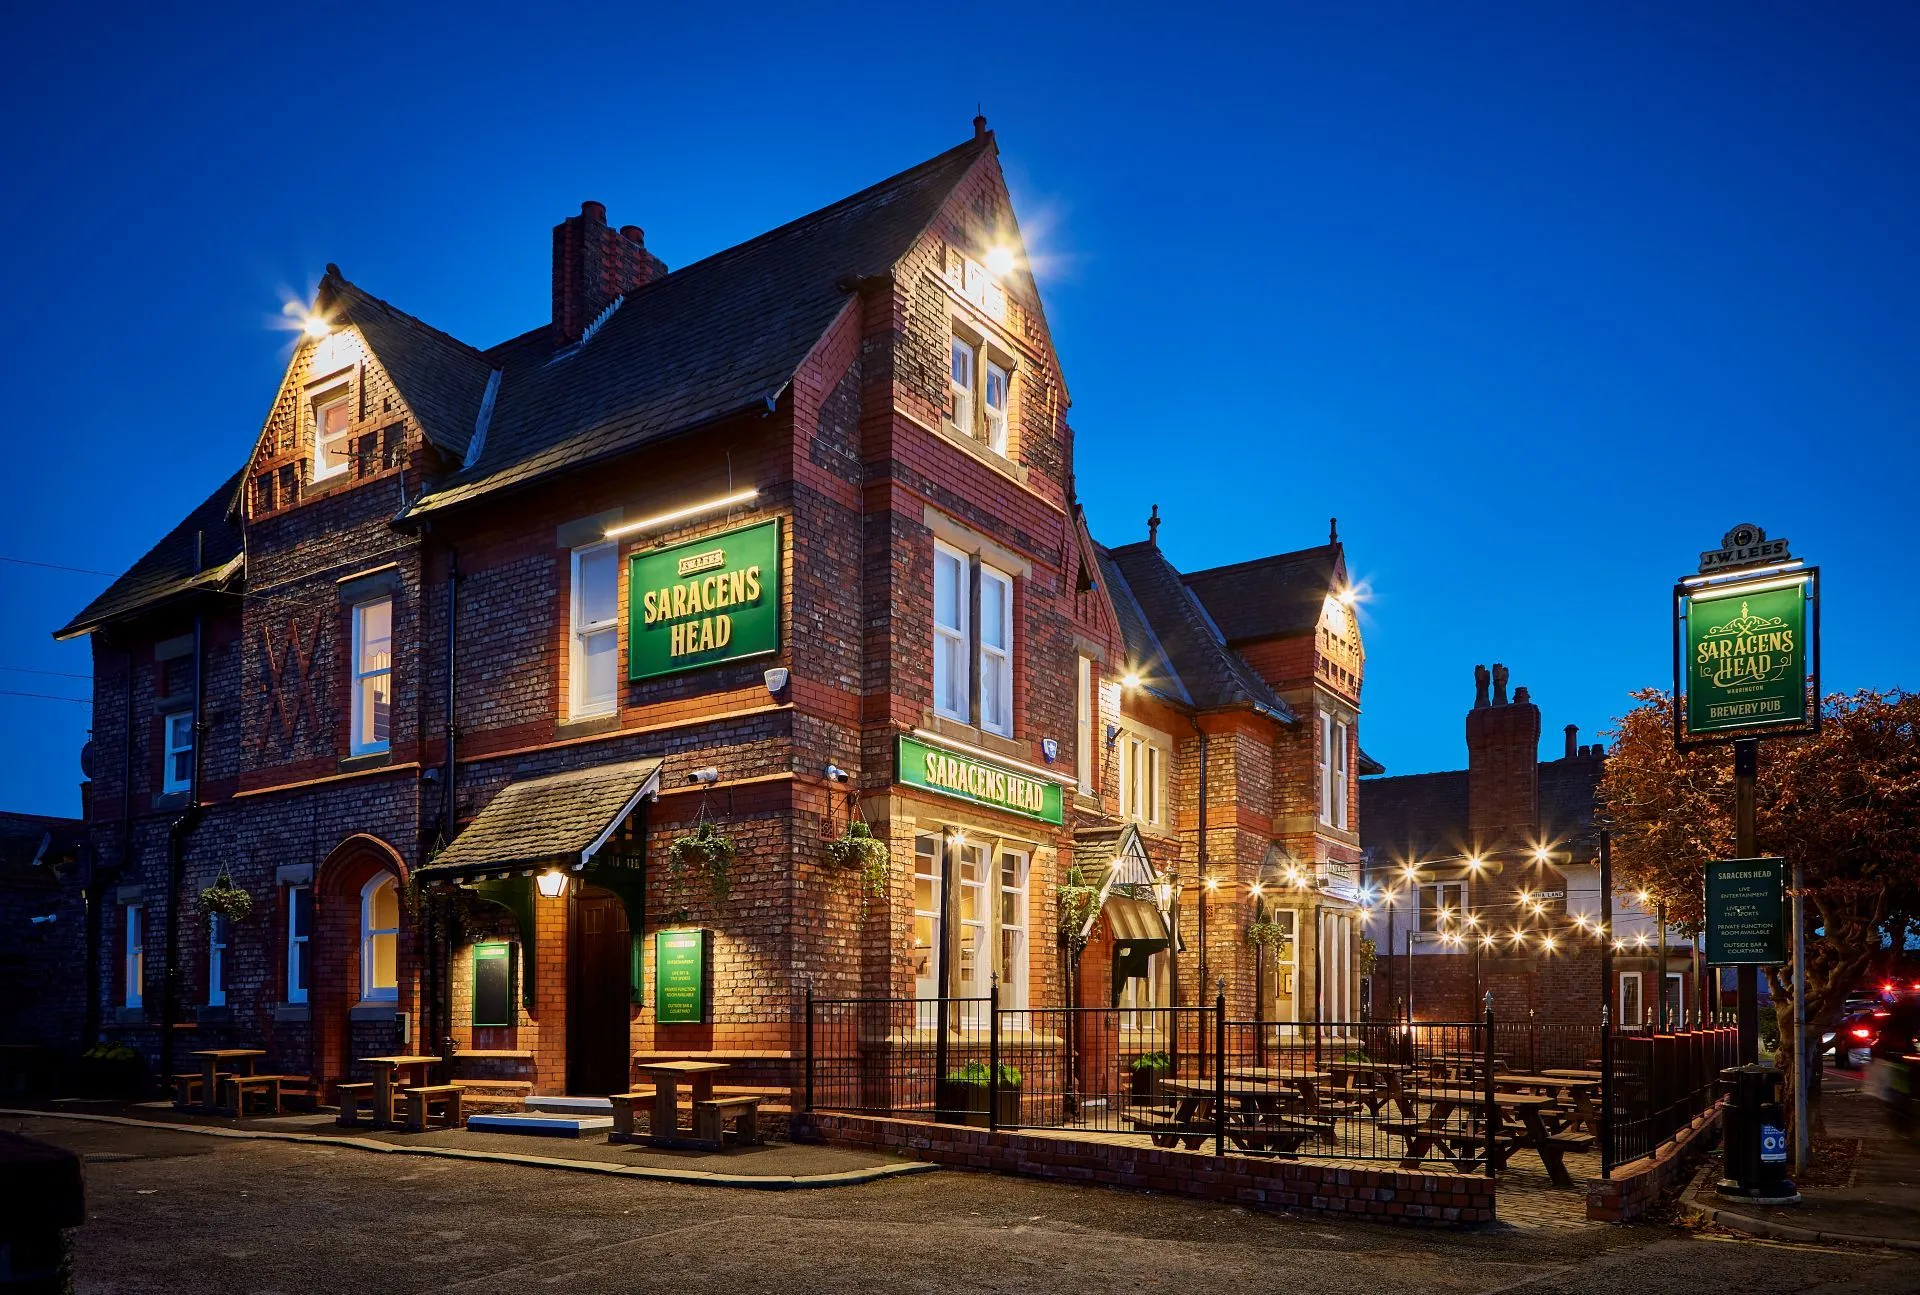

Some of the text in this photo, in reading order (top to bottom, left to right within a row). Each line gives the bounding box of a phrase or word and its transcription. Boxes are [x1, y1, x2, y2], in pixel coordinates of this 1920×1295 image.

[644, 566, 761, 624] SARACENS
[670, 614, 731, 657] HEAD
[1697, 630, 1794, 664] SARACENS
[1714, 654, 1771, 687] HEAD
[1726, 685, 1764, 694] WARRINGTON
[1710, 700, 1781, 718] BREWERY PUB
[926, 752, 1043, 812] SARACENS HEAD
[1717, 870, 1772, 880] SARACENS HEAD
[1720, 891, 1768, 899] ENTERTAINMENT
